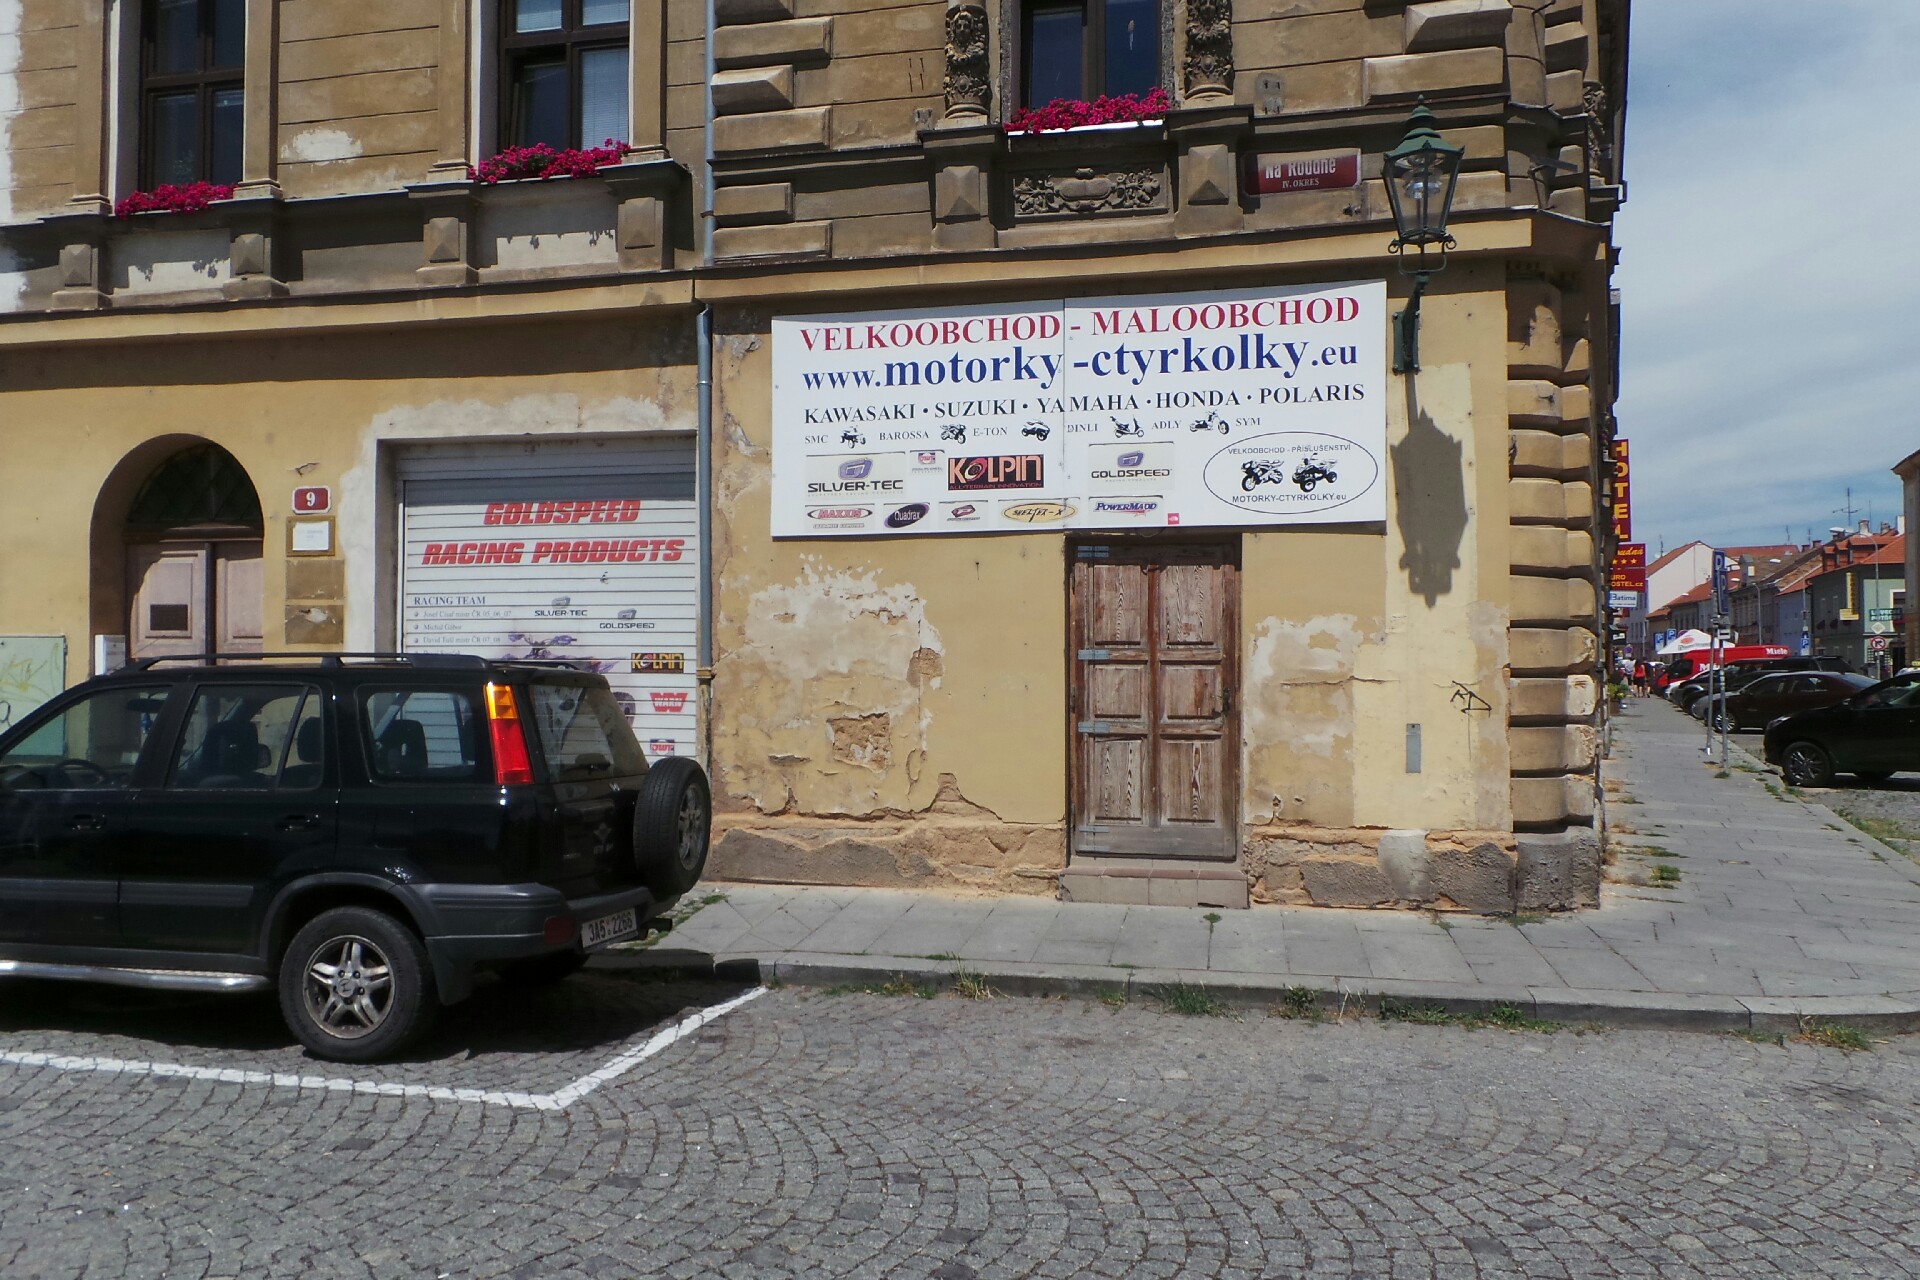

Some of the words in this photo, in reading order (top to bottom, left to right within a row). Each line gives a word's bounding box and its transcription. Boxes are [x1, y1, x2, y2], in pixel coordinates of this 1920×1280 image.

[1265, 163, 1282, 179] Na
[1293, 178, 1320, 187] OKRES
[800, 314, 1060, 351] VELKOOBCHOD
[1090, 296, 1359, 335] MALOOBCHOD
[804, 403, 916, 424] KAWASAKI
[934, 399, 1016, 419] SUZUKI
[1037, 393, 1140, 414] YAMAHA
[1156, 389, 1241, 409] HONDA
[1258, 383, 1365, 405] POLARIS
[805, 435, 828, 444] SMC
[880, 431, 930, 441] BAROSSA
[973, 427, 1008, 436] E-TON
[1152, 420, 1181, 430] ADLY
[1236, 417, 1261, 426] SYM
[1228, 447, 1285, 455] VELKOOBCHOD
[950, 455, 1042, 484] KOLPIN
[1091, 468, 1171, 479] GOLDSPEED
[808, 480, 904, 493] SILVER-TEC
[306, 491, 316, 507] 9
[1232, 493, 1347, 503] MOTORKY-CTYRKOLKY.eu
[483, 500, 641, 526] GOLDSPEED
[894, 509, 921, 521] Quadrax
[422, 542, 525, 565] RACING
[531, 539, 685, 564] PRODUCTS
[414, 596, 453, 605] RACING
[456, 596, 486, 605] TEAM
[1765, 647, 1788, 655] Miele
[654, 698, 683, 707] WARN
